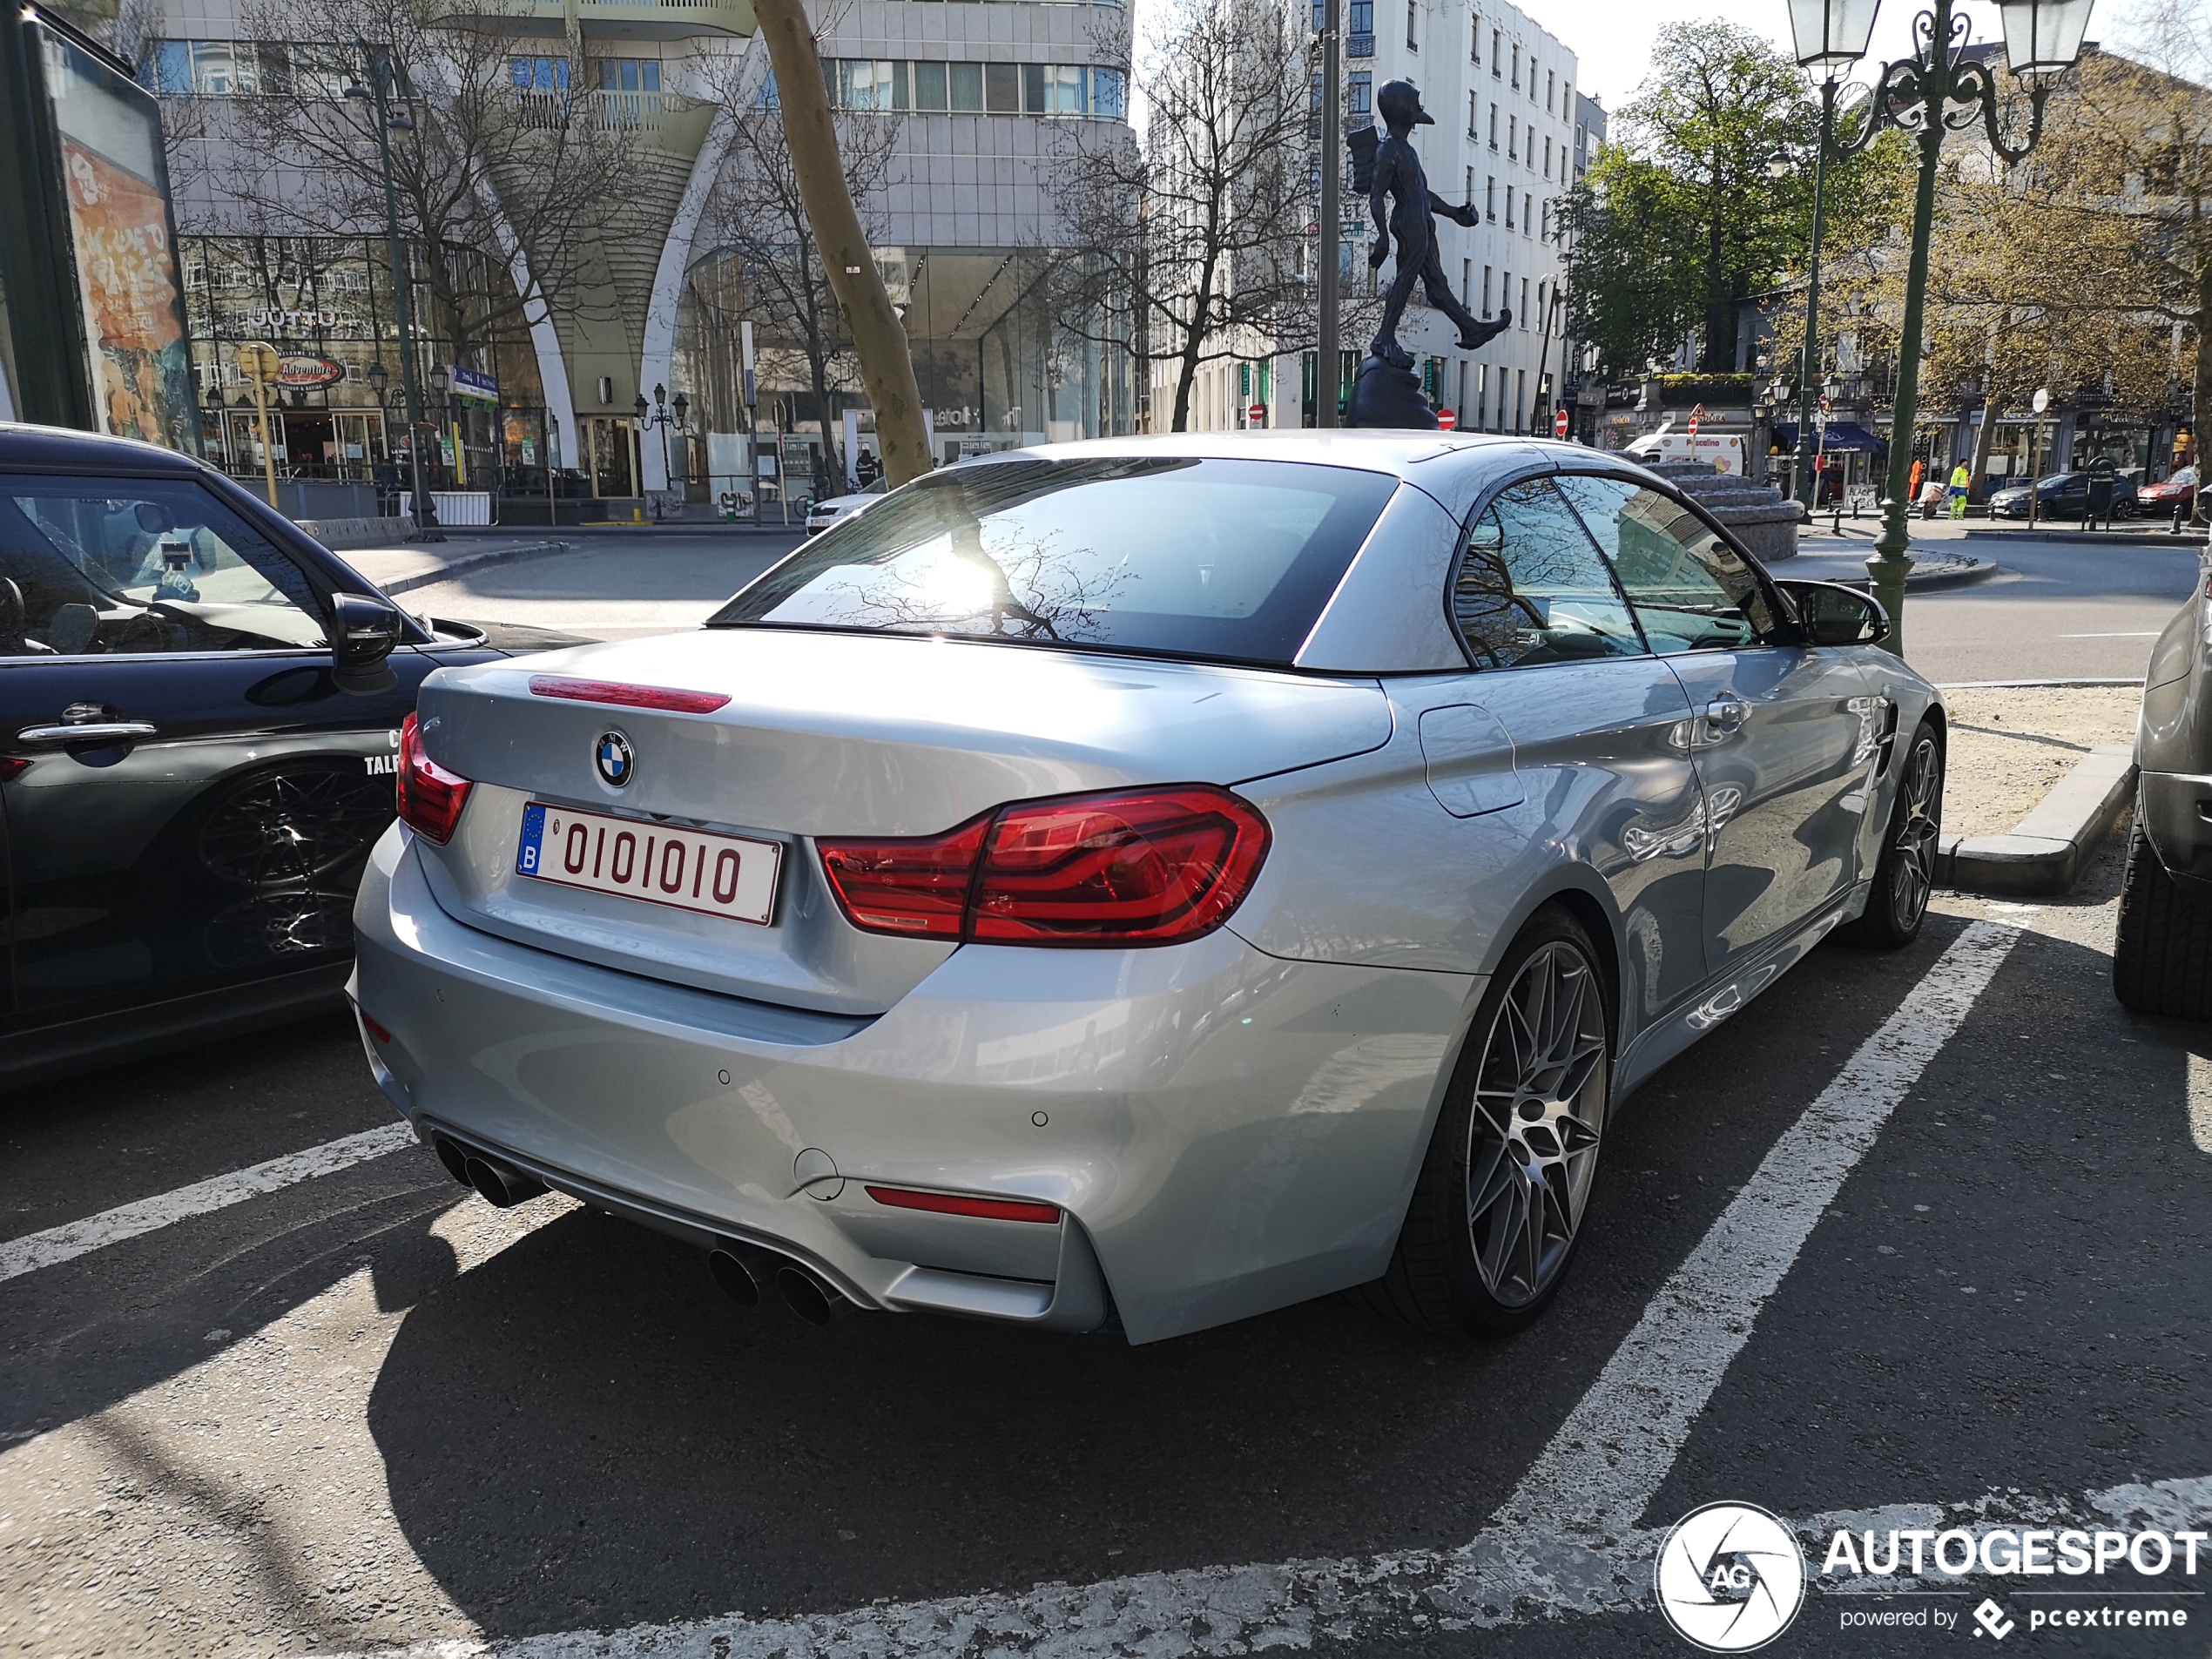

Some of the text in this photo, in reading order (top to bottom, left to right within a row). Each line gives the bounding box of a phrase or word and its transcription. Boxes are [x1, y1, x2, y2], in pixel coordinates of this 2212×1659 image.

[282, 364, 332, 374] Adventure
[1688, 414, 1726, 422] PNDORA
[598, 733, 628, 753] BMW
[523, 846, 536, 869] B
